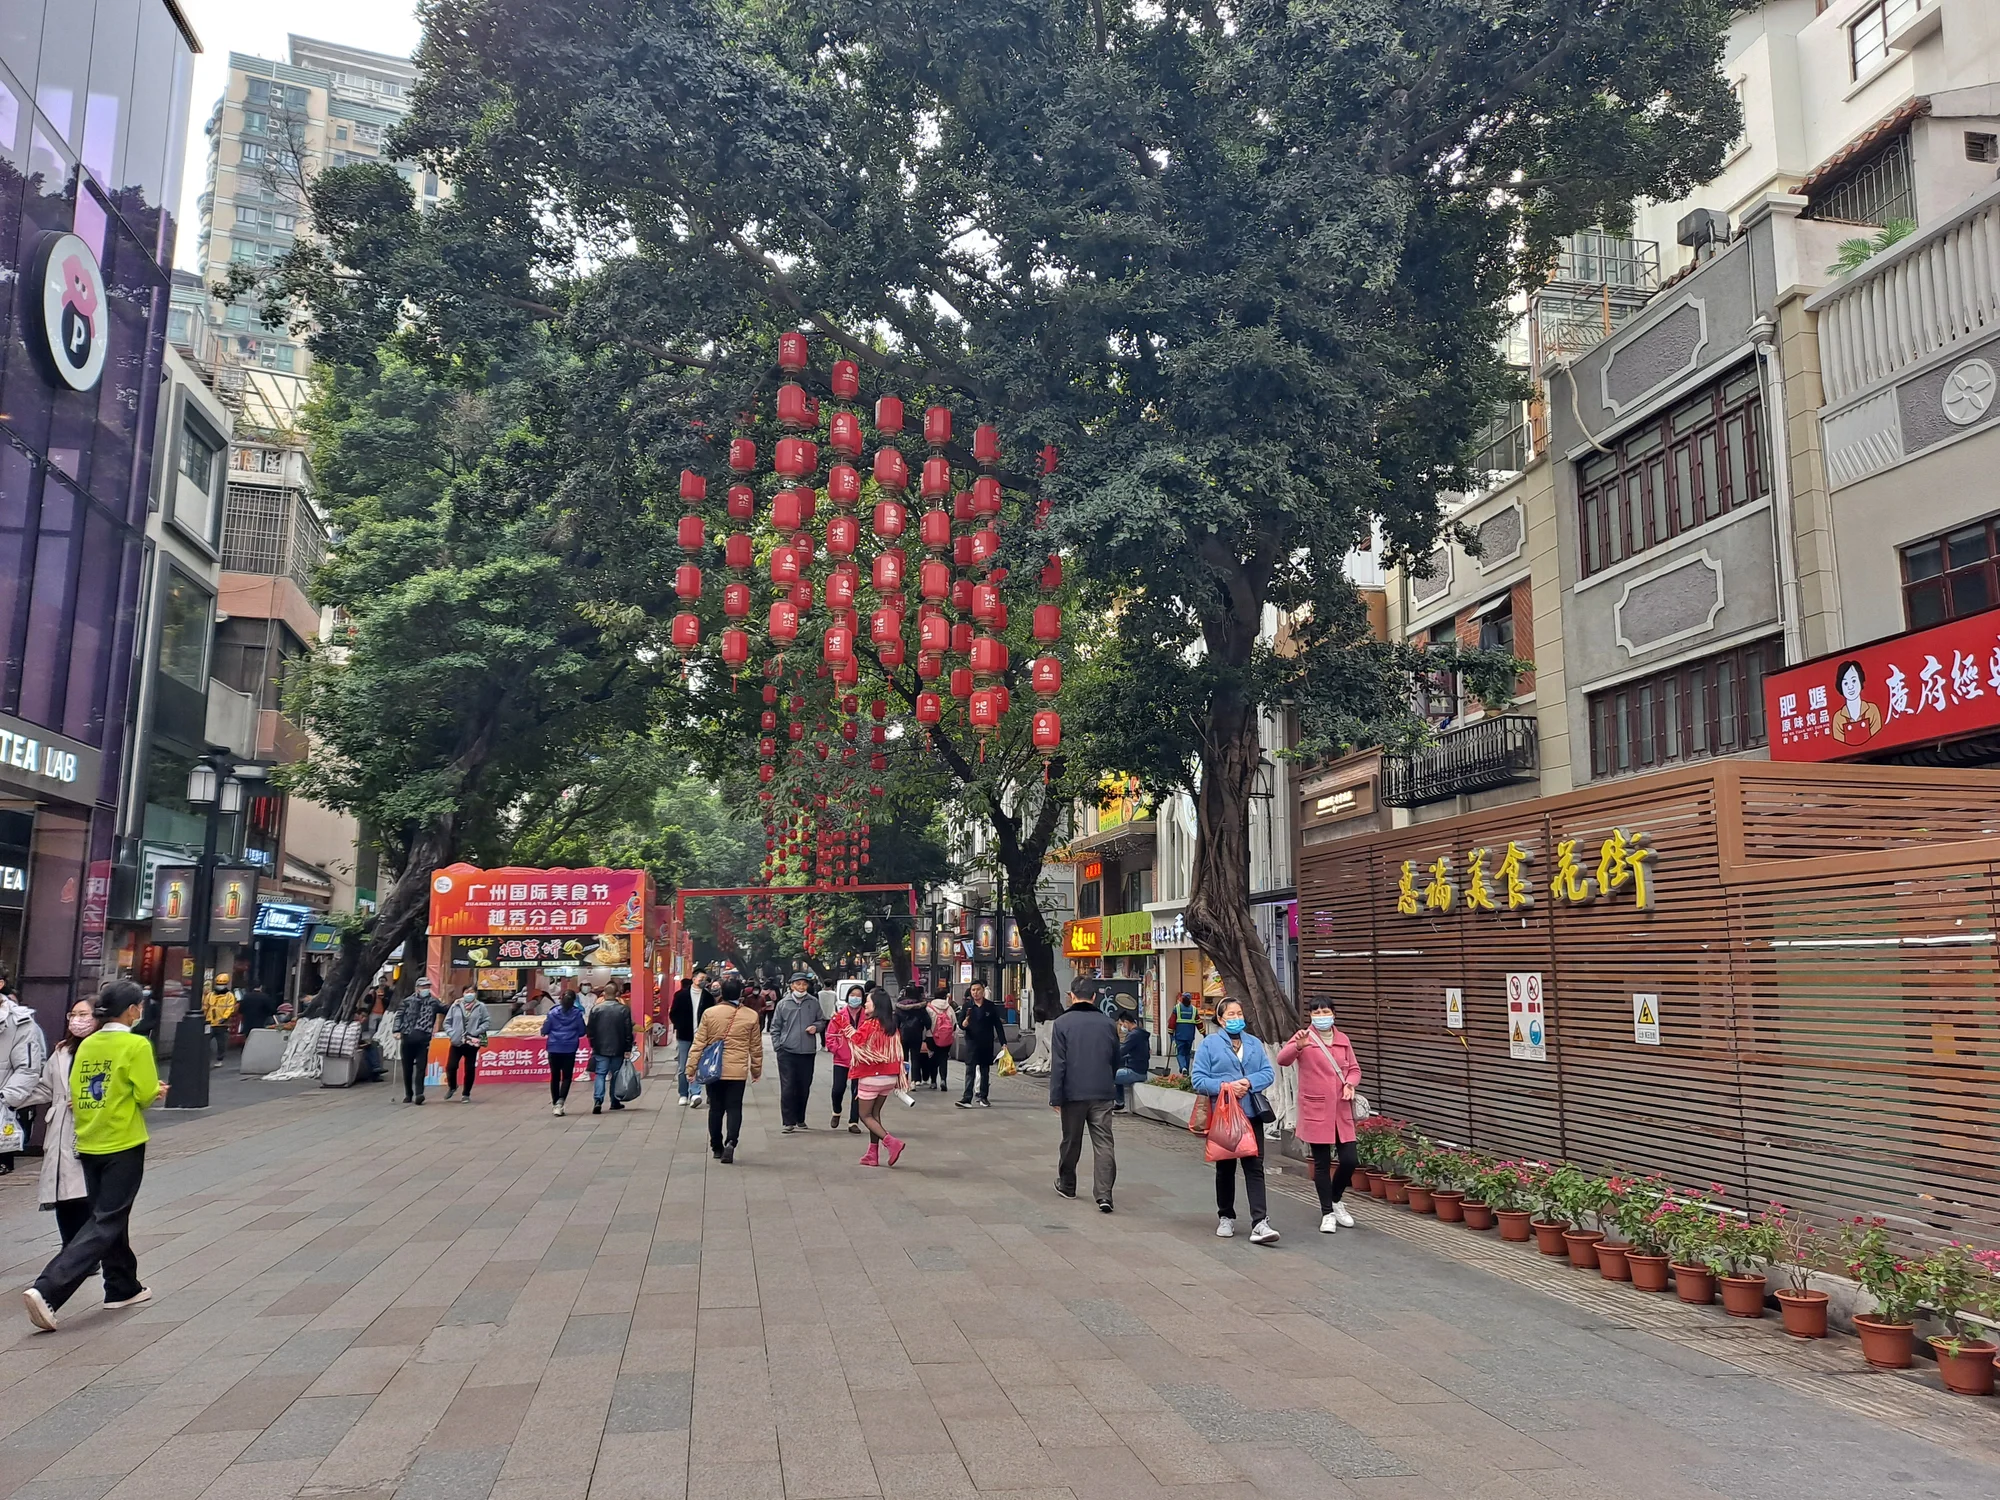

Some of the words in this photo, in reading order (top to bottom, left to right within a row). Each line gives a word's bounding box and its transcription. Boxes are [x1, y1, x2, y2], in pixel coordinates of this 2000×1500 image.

[0, 728, 41, 772] TEA
[44, 746, 78, 783] LAB
[468, 884, 609, 901] 广州国际美食节
[488, 909, 588, 926] 越秀分会场
